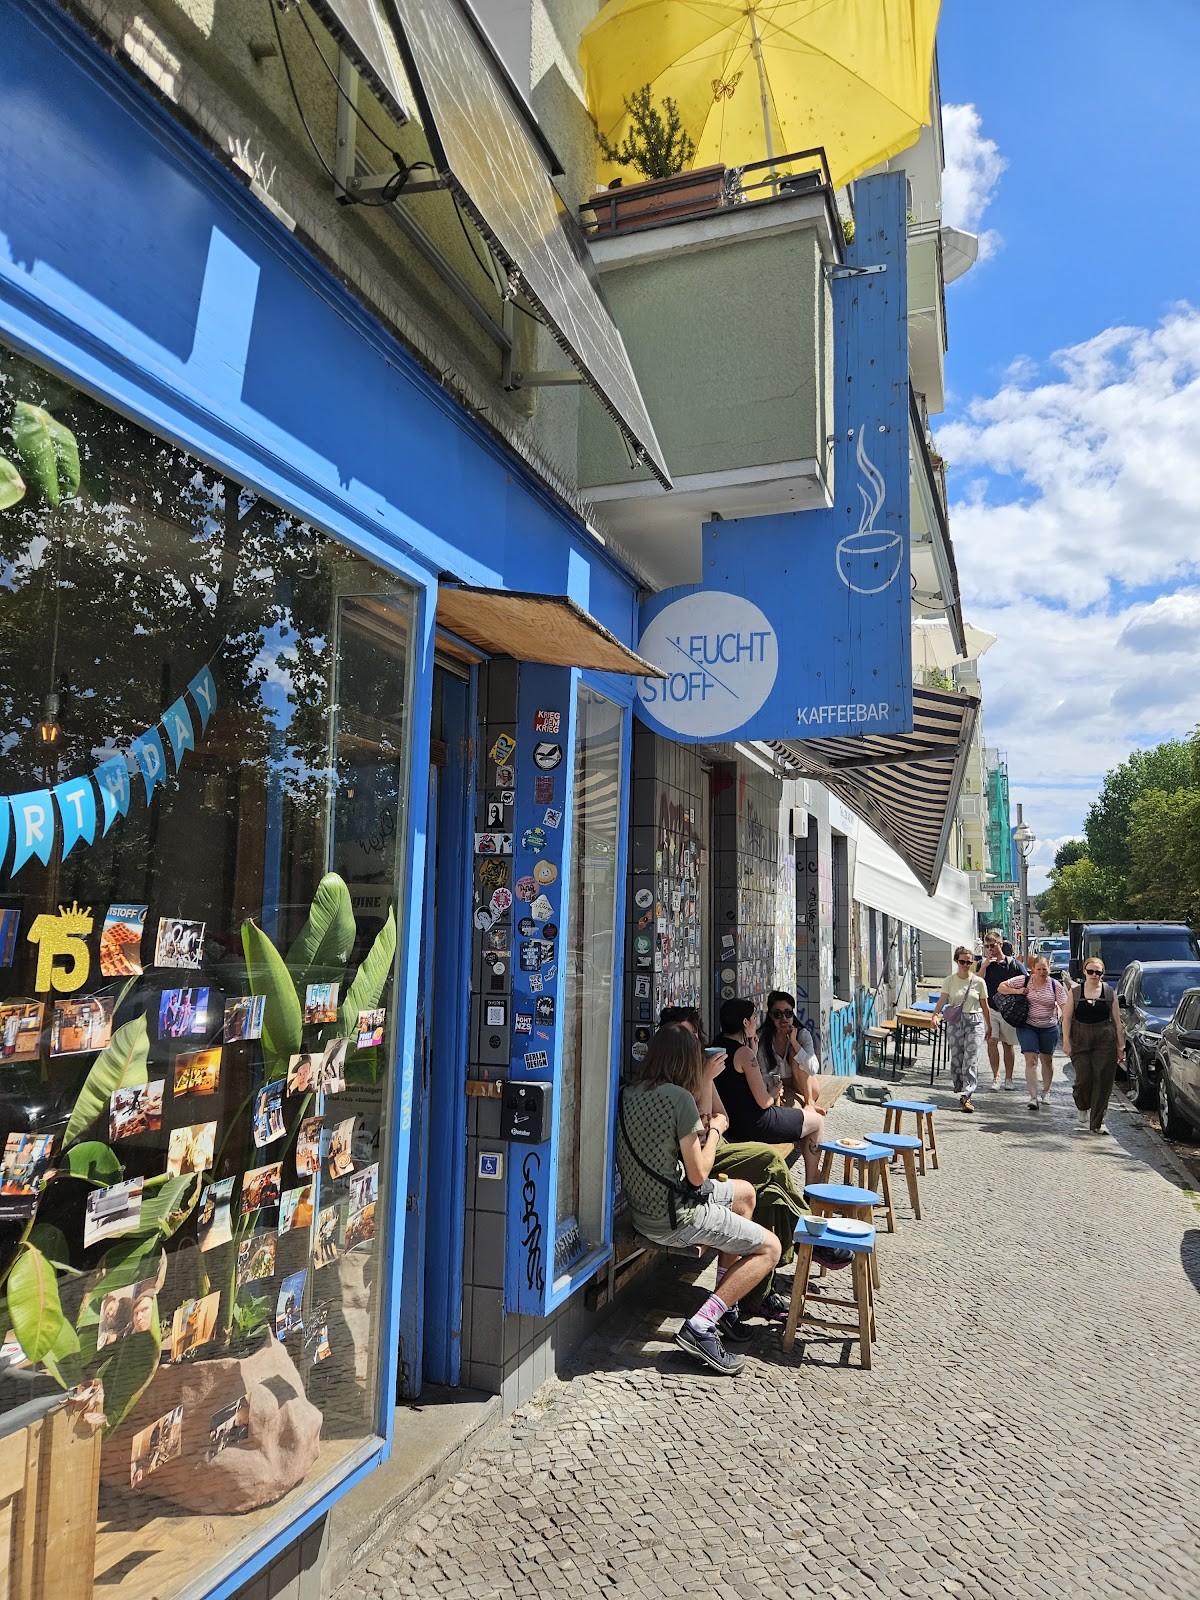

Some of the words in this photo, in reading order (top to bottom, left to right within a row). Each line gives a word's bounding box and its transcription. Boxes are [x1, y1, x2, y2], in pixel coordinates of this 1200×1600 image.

[538, 711, 561, 720] KRIEG
[797, 703, 889, 725] KAFFEEBAR
[543, 718, 560, 727] DEM
[536, 724, 559, 734] KRIEG
[27, 914, 94, 993] 15
[525, 1051, 546, 1061] BERLIN
[526, 1058, 548, 1069] DESIGN
